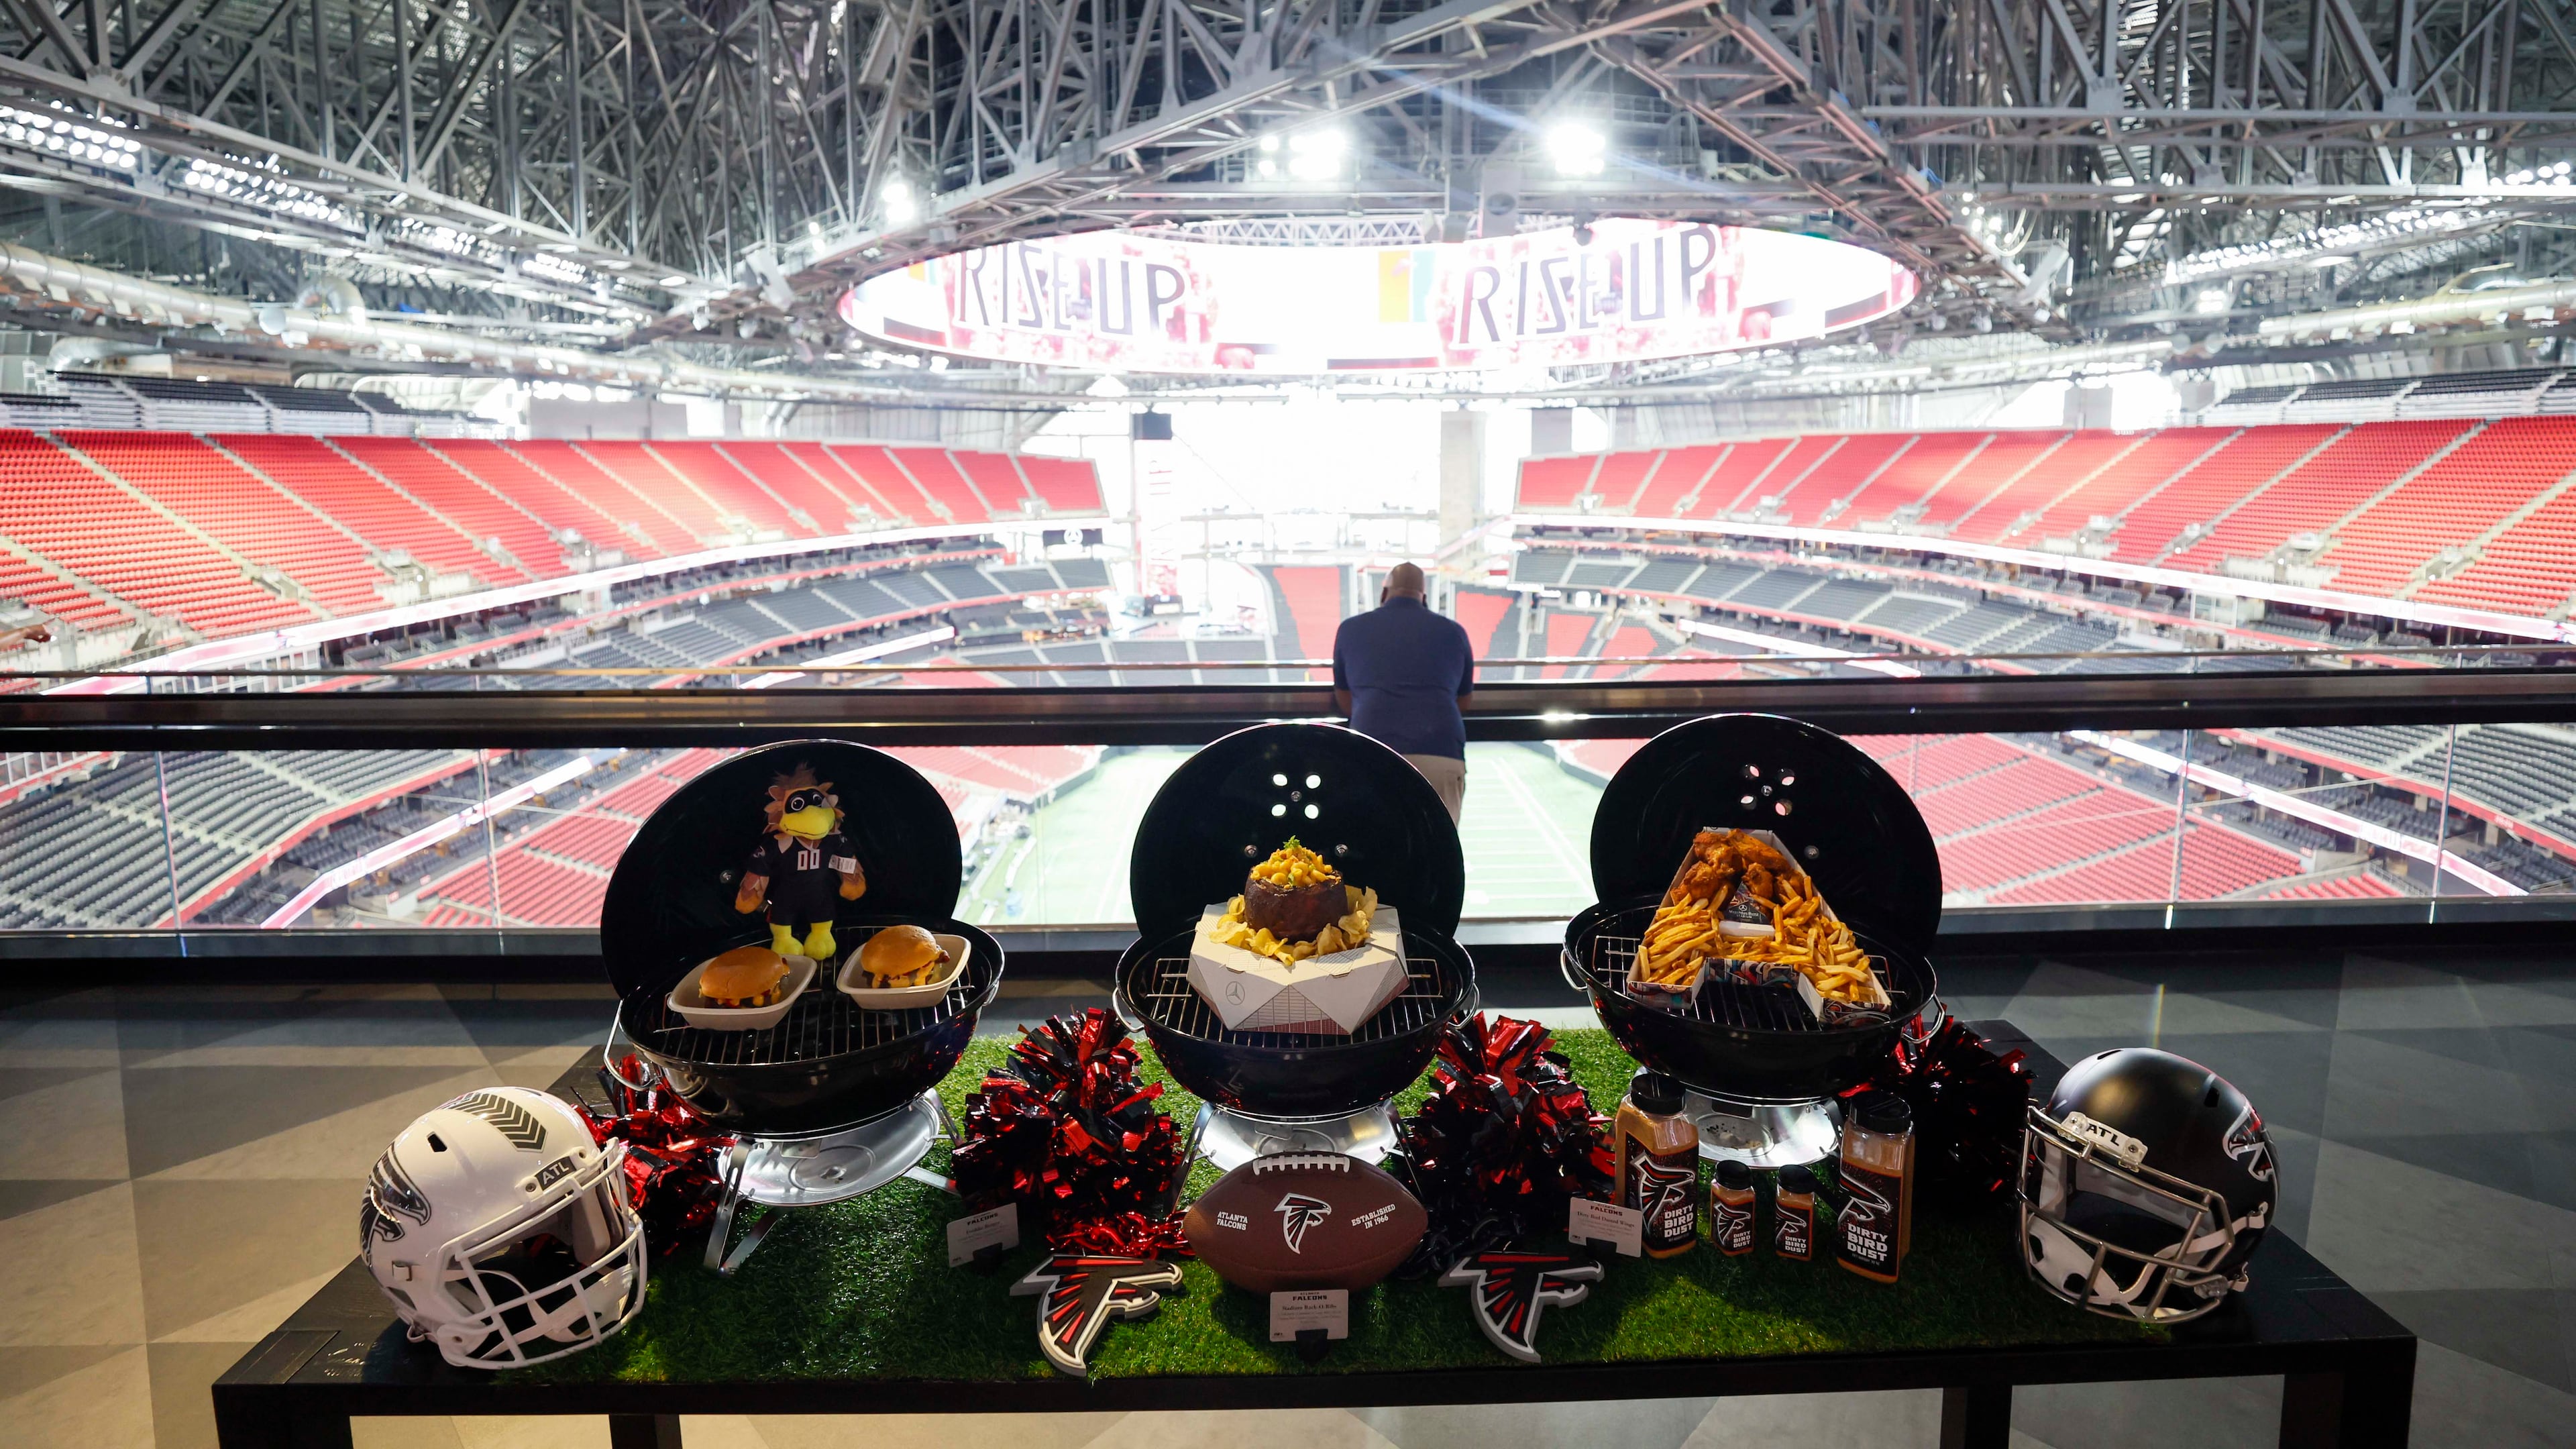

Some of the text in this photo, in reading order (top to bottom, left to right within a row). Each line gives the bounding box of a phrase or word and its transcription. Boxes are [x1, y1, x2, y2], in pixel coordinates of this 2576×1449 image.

[959, 244, 1186, 335] RISE UP
[1458, 227, 1717, 344] RISE UP
[797, 849, 820, 871] 00
[2086, 1123, 2119, 1146] ATL
[542, 1162, 570, 1185] ATL
[1217, 1211, 1248, 1224] ATLANTA
[1351, 1203, 1396, 1226] ESTABLISHED
[1591, 1205, 1623, 1216] FALCONS
[1664, 1203, 1694, 1219] DIRTY
[967, 1212, 999, 1226] FALCONS
[1216, 1218, 1247, 1231] FALCONS
[1364, 1214, 1389, 1230] IN 1966
[1664, 1212, 1694, 1229] BIRD
[1664, 1221, 1694, 1238] DUST
[1733, 1230, 1751, 1238] DIRTY
[1847, 1223, 1888, 1242] DIRTY
[1733, 1235, 1751, 1243] BIRD
[1733, 1240, 1751, 1248] DUST
[1785, 1240, 1807, 1248] BIRD
[1847, 1231, 1888, 1252] BIRD
[1785, 1245, 1807, 1253] DUST
[1847, 1241, 1888, 1261] DUST
